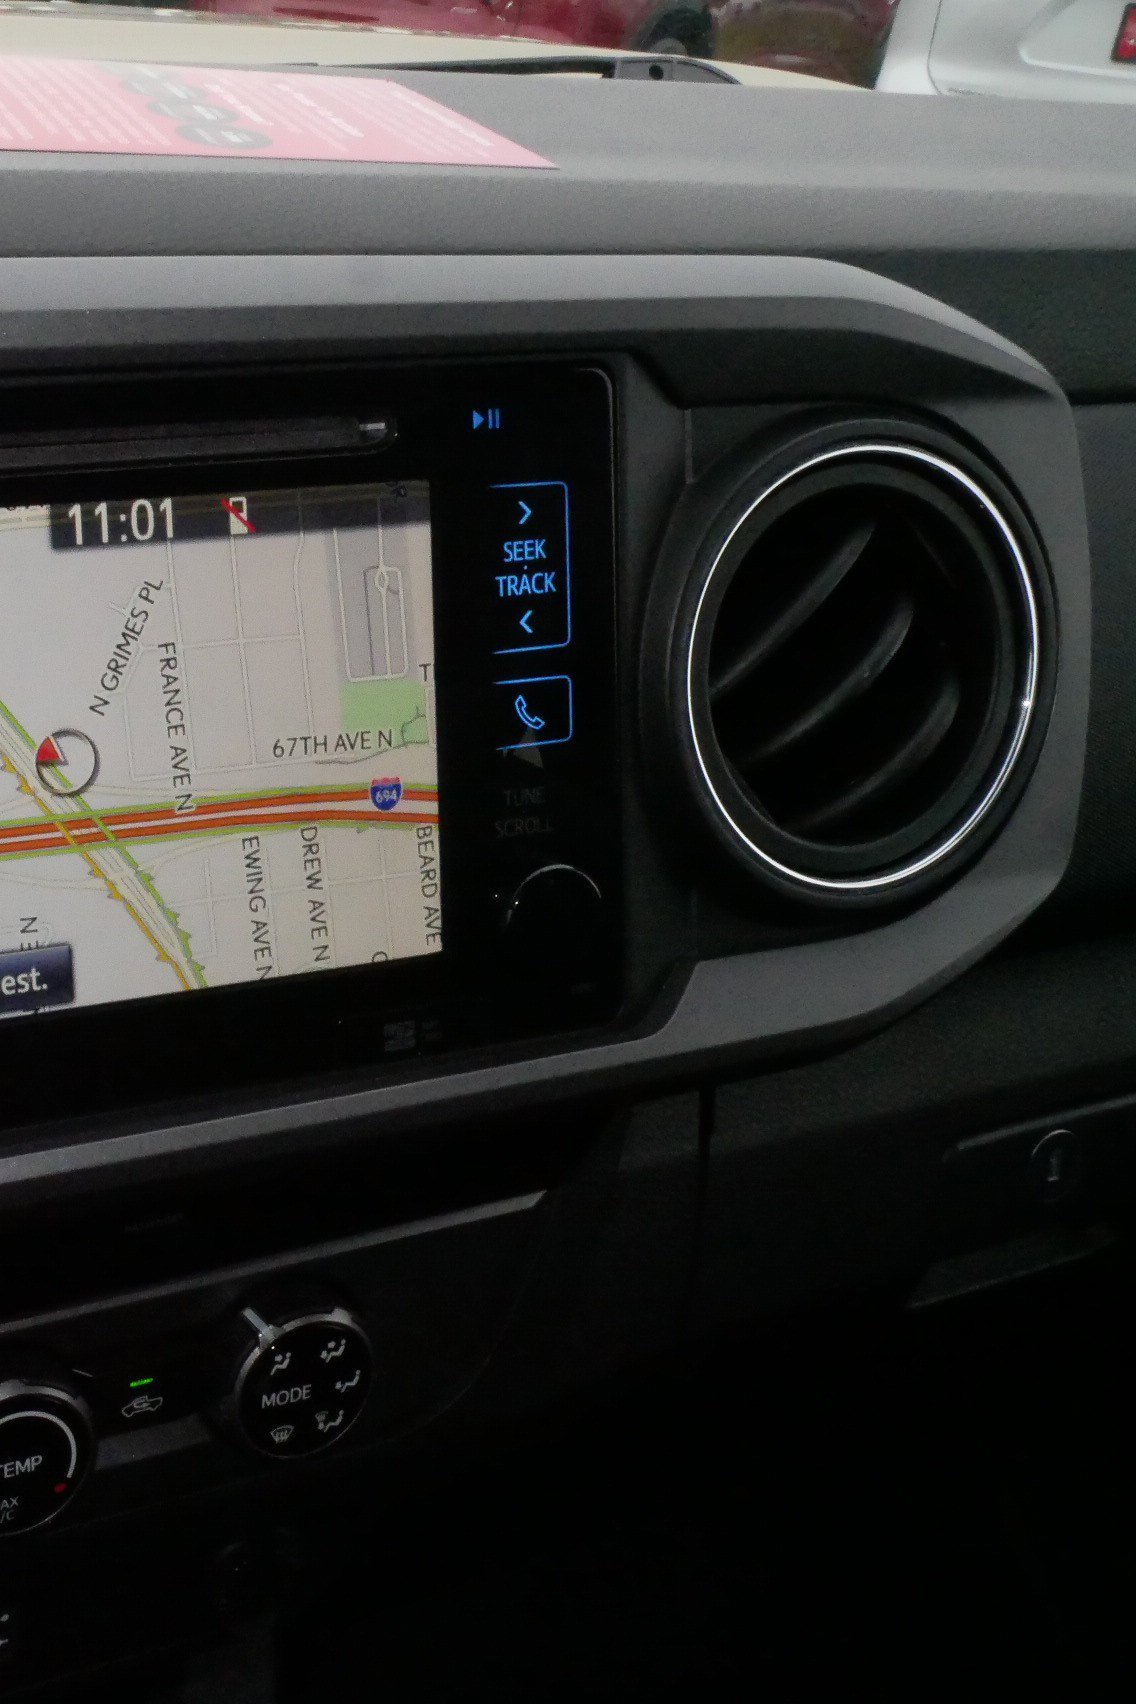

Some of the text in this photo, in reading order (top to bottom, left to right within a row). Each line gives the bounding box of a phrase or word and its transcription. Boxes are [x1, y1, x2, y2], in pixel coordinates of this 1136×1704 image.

[68, 496, 175, 547] 11:01
[502, 539, 547, 564] SEEK
[495, 571, 557, 598] TRACK
[89, 577, 166, 717] N GRIMES PL
[157, 641, 194, 812] FRANCE AVE N
[272, 728, 393, 757] 67TH AVE N
[374, 789, 398, 803] 694
[494, 815, 554, 839] SCROLL
[241, 834, 267, 913] EWING
[415, 825, 442, 946] BEARD AVE
[300, 827, 331, 963] DREW AVE N
[250, 920, 273, 962] AVE
[260, 1382, 312, 1410] MODE
